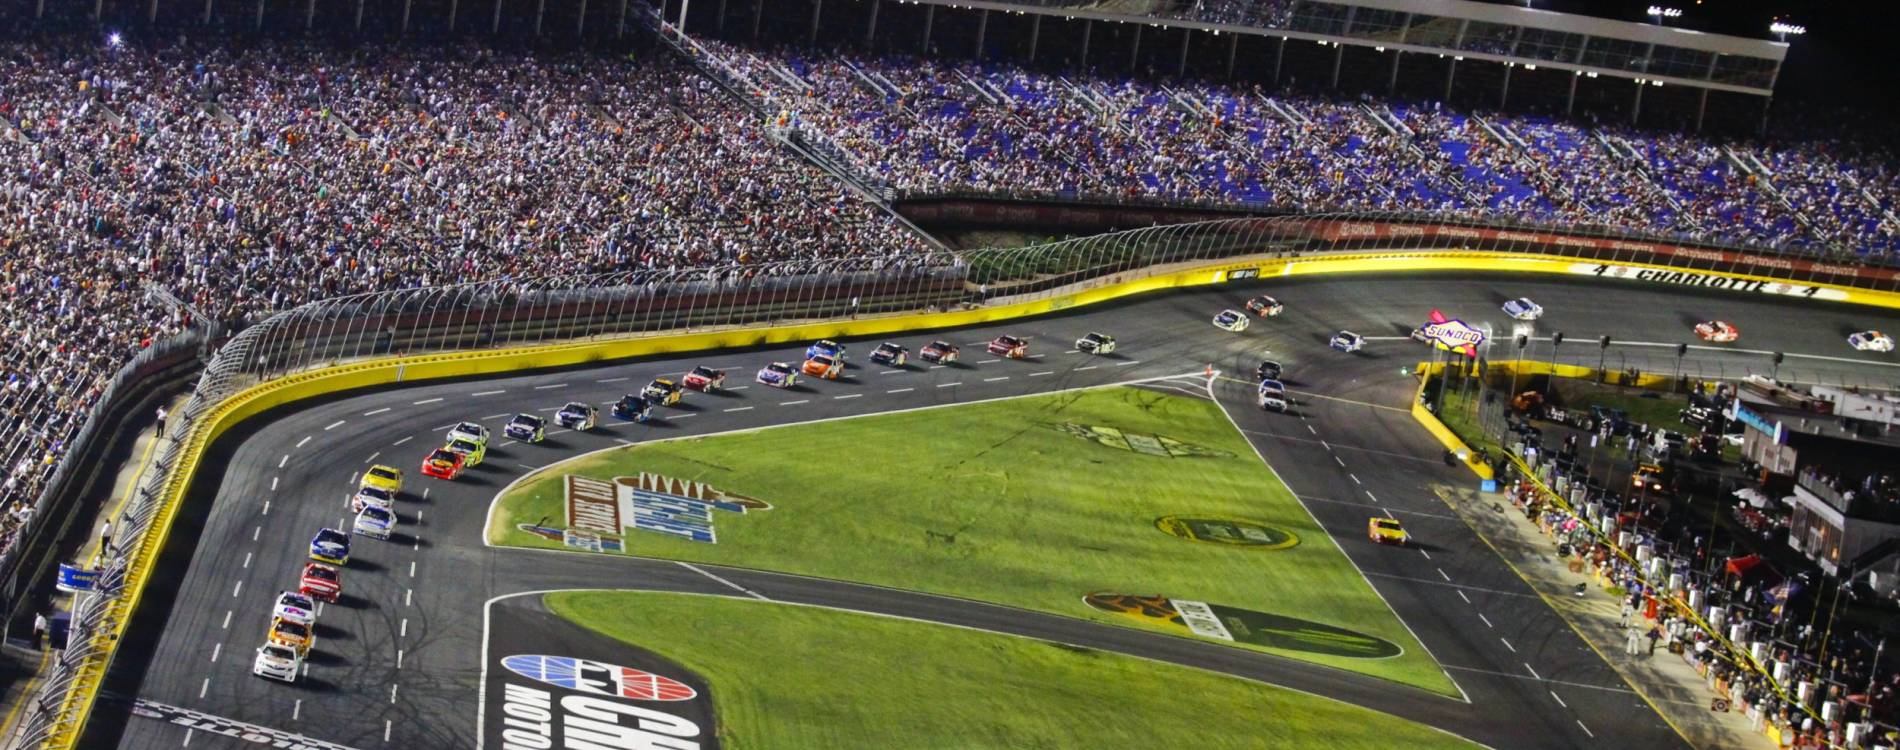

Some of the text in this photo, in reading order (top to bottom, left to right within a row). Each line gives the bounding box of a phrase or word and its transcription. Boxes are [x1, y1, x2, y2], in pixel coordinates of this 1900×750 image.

[1593, 265, 1820, 298] 4 CHARLOTTE 4
[1429, 326, 1479, 342] SUNOCO
